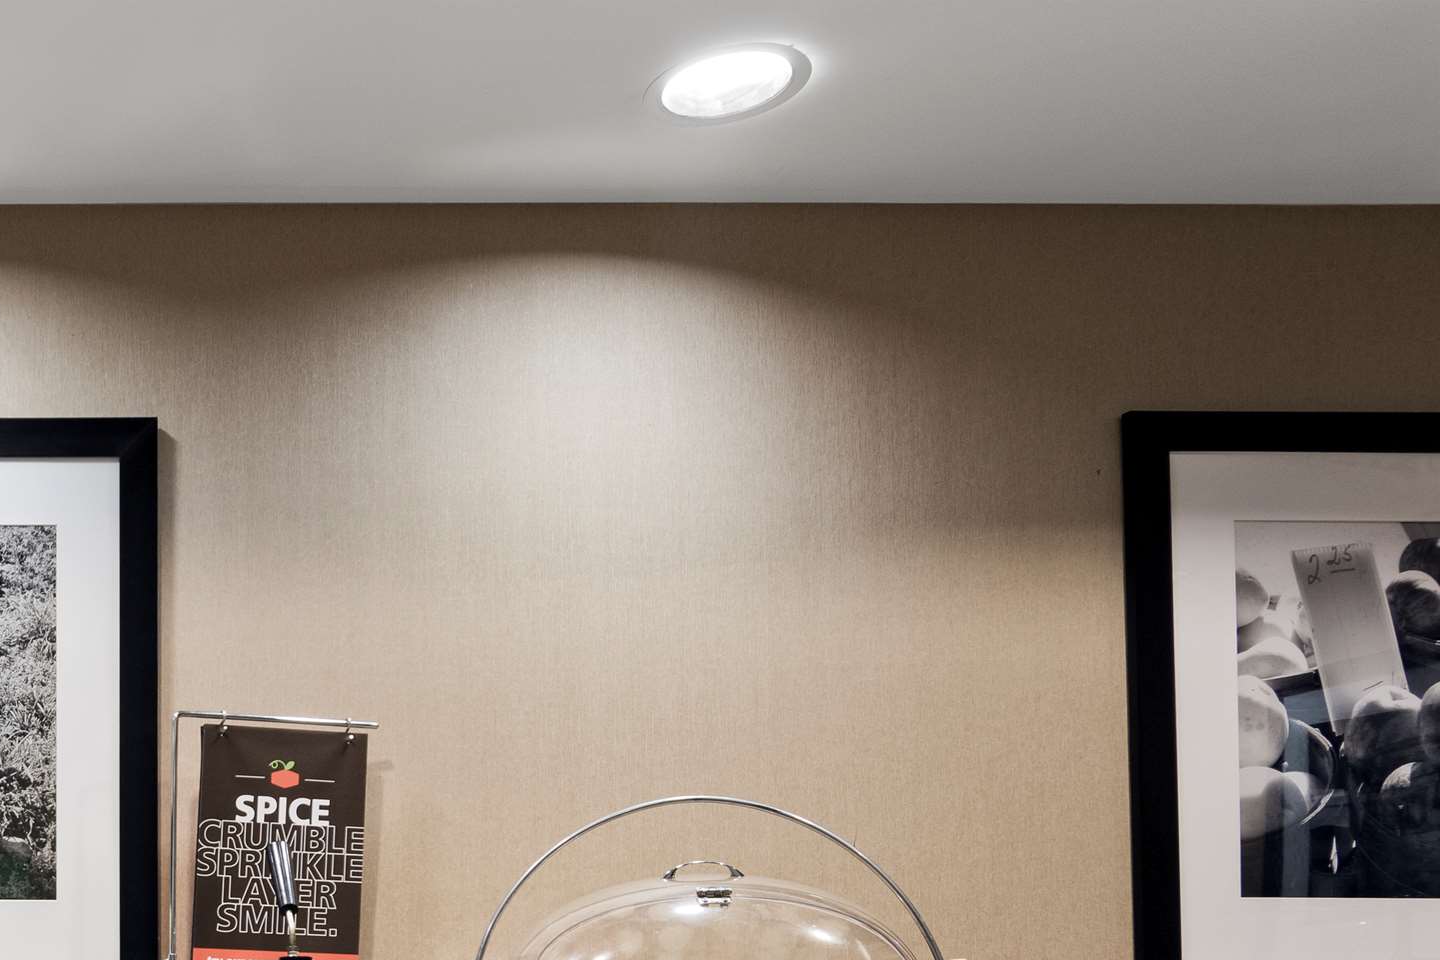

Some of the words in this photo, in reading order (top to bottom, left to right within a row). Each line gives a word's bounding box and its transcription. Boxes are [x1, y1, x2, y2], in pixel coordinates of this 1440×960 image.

[1307, 553, 1322, 585] 2
[235, 795, 331, 826] SPICE
[198, 818, 365, 856] CRUMBLE
